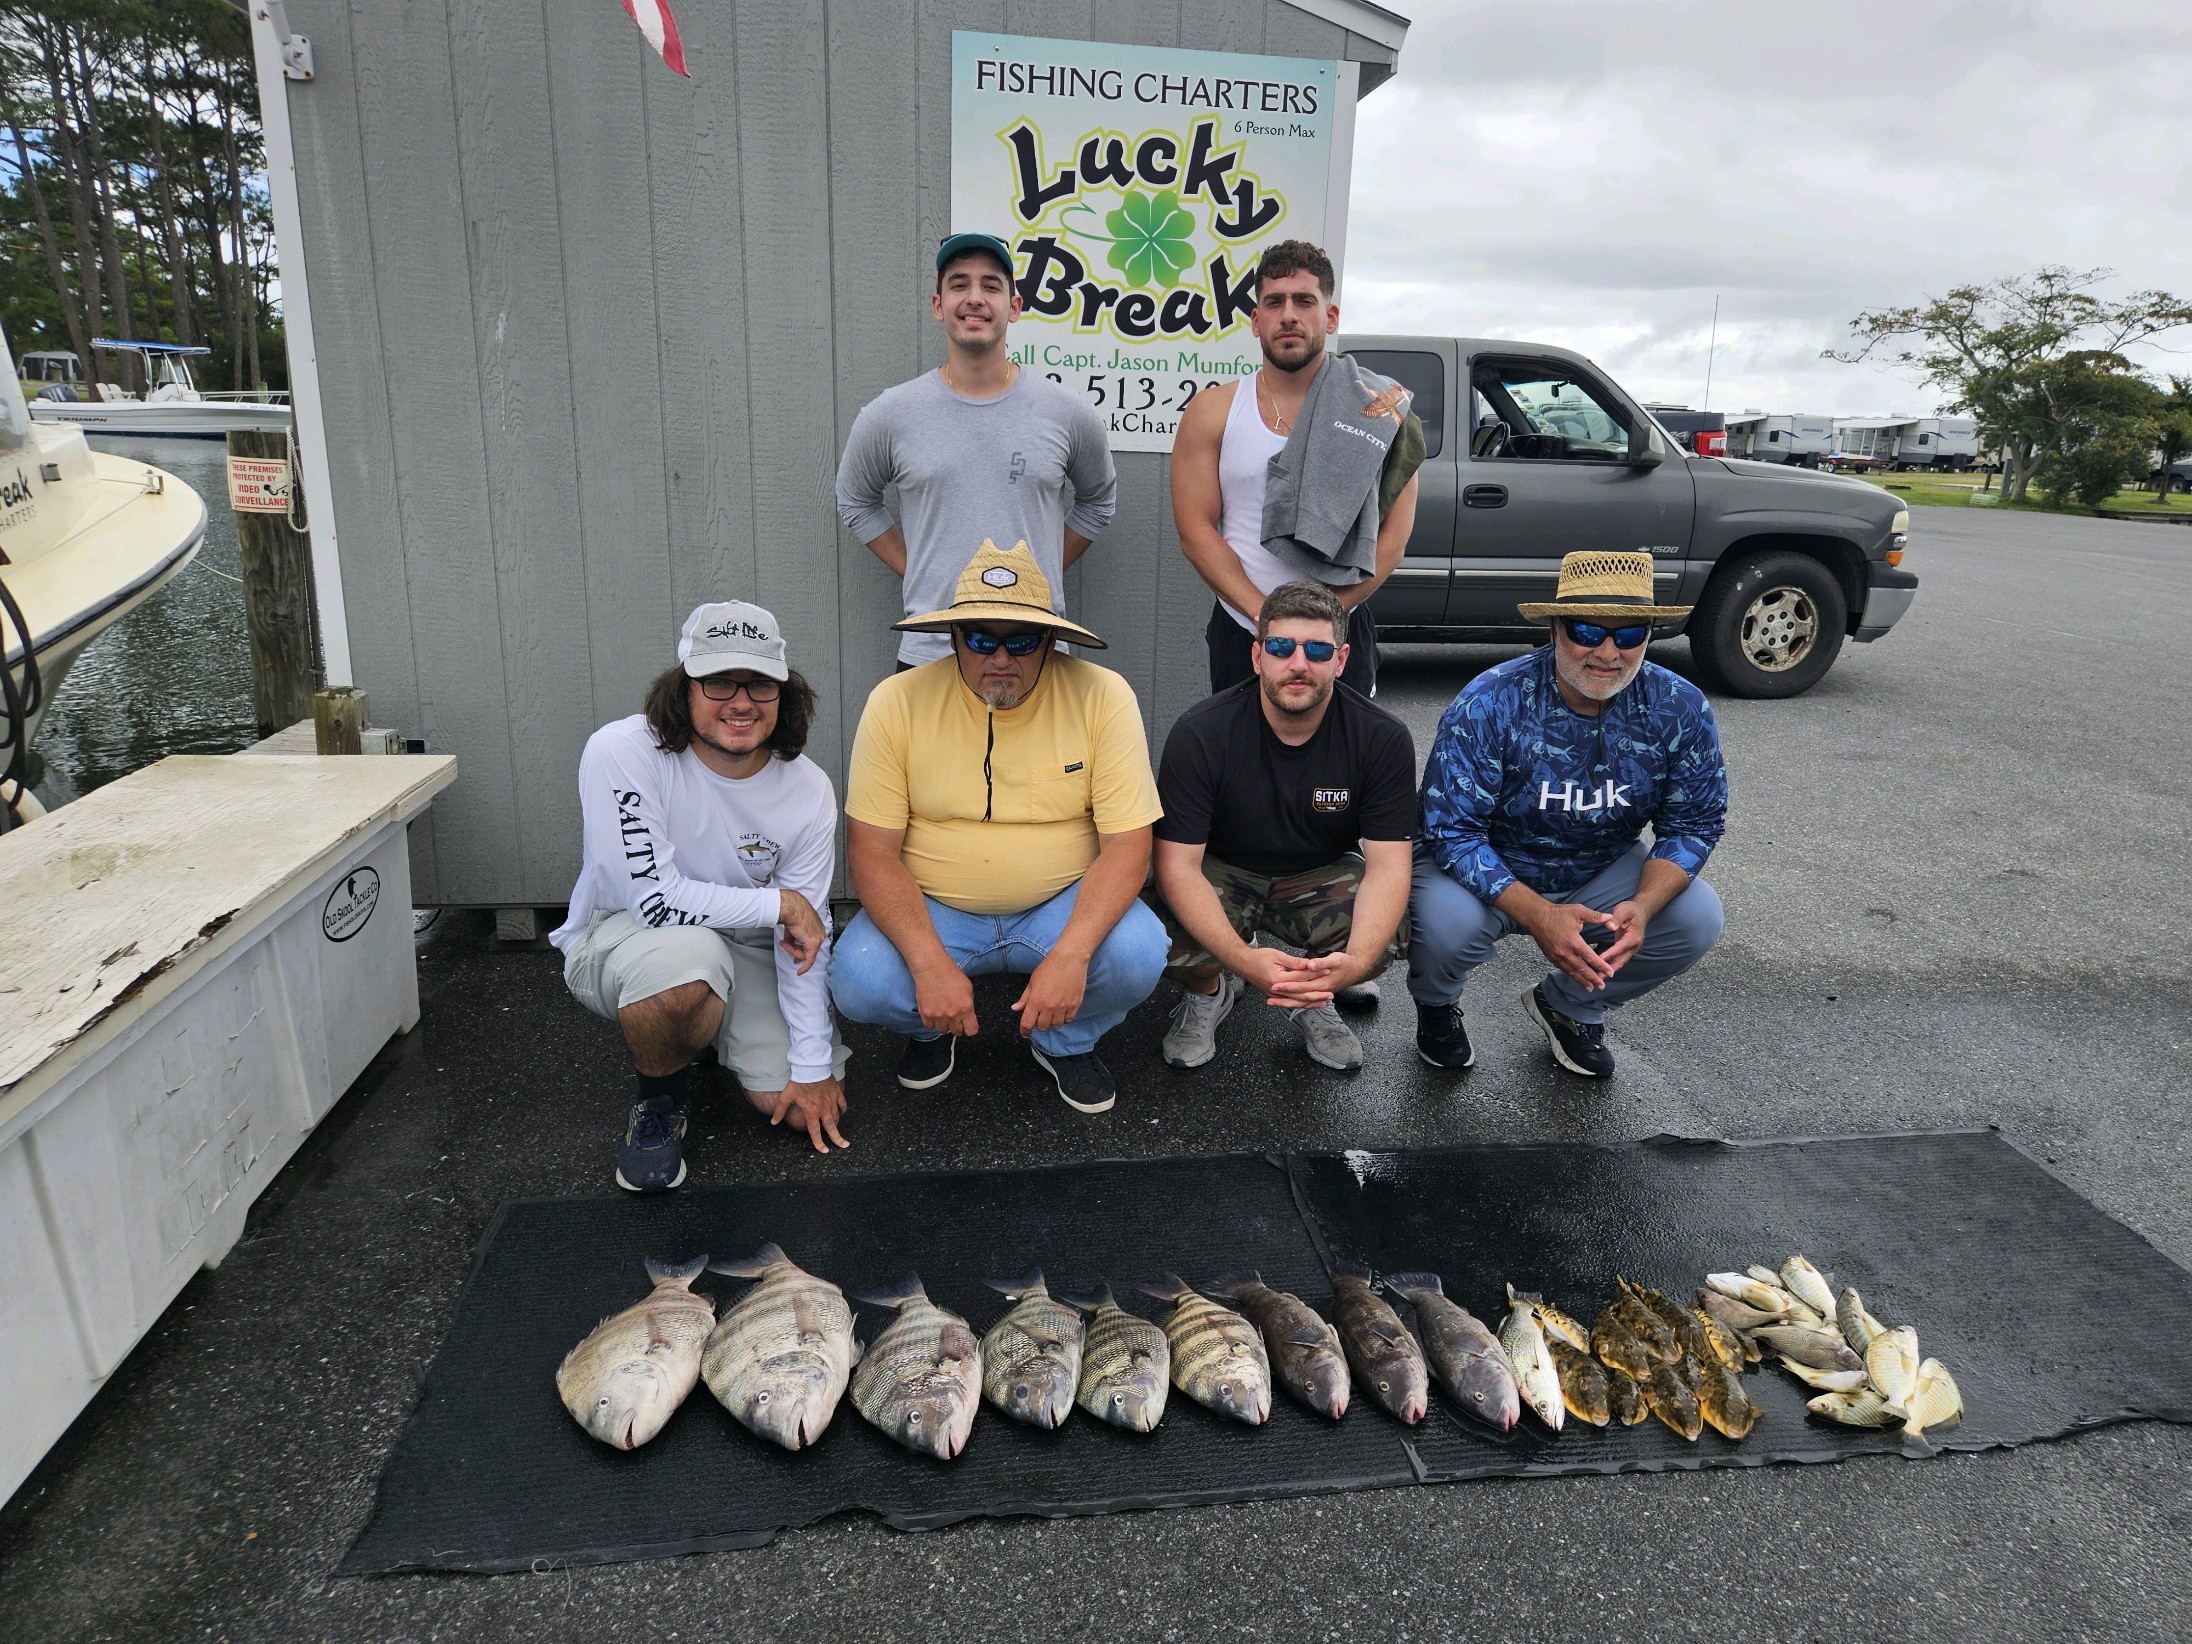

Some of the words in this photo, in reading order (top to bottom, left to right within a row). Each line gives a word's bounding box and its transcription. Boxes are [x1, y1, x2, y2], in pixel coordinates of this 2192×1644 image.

[976, 60, 1124, 100] FISHING
[1134, 73, 1319, 115] CHARTERS
[1234, 120, 1242, 133] 6
[1246, 121, 1285, 136] Person
[1289, 123, 1316, 138] Max
[1008, 122, 1280, 238] Lucky
[1016, 236, 1258, 337] Break
[1043, 345, 1101, 372] Capt.
[1107, 349, 1169, 371] Jason
[1334, 421, 1366, 437] OCEAN
[232, 473, 265, 481] PROTECTED
[248, 465, 283, 473] PREMISES
[0, 466, 33, 508] eak
[234, 495, 289, 506] SURVEILLANCE
[238, 484, 260, 493] VIDEO
[1315, 791, 1348, 801] SITKA
[1539, 779, 1632, 811] Huk
[613, 789, 660, 881] SALTY
[326, 914, 337, 929] OLD
[337, 903, 353, 920] SKOOL
[354, 887, 370, 908] TACKLE
[371, 881, 377, 893] CO
